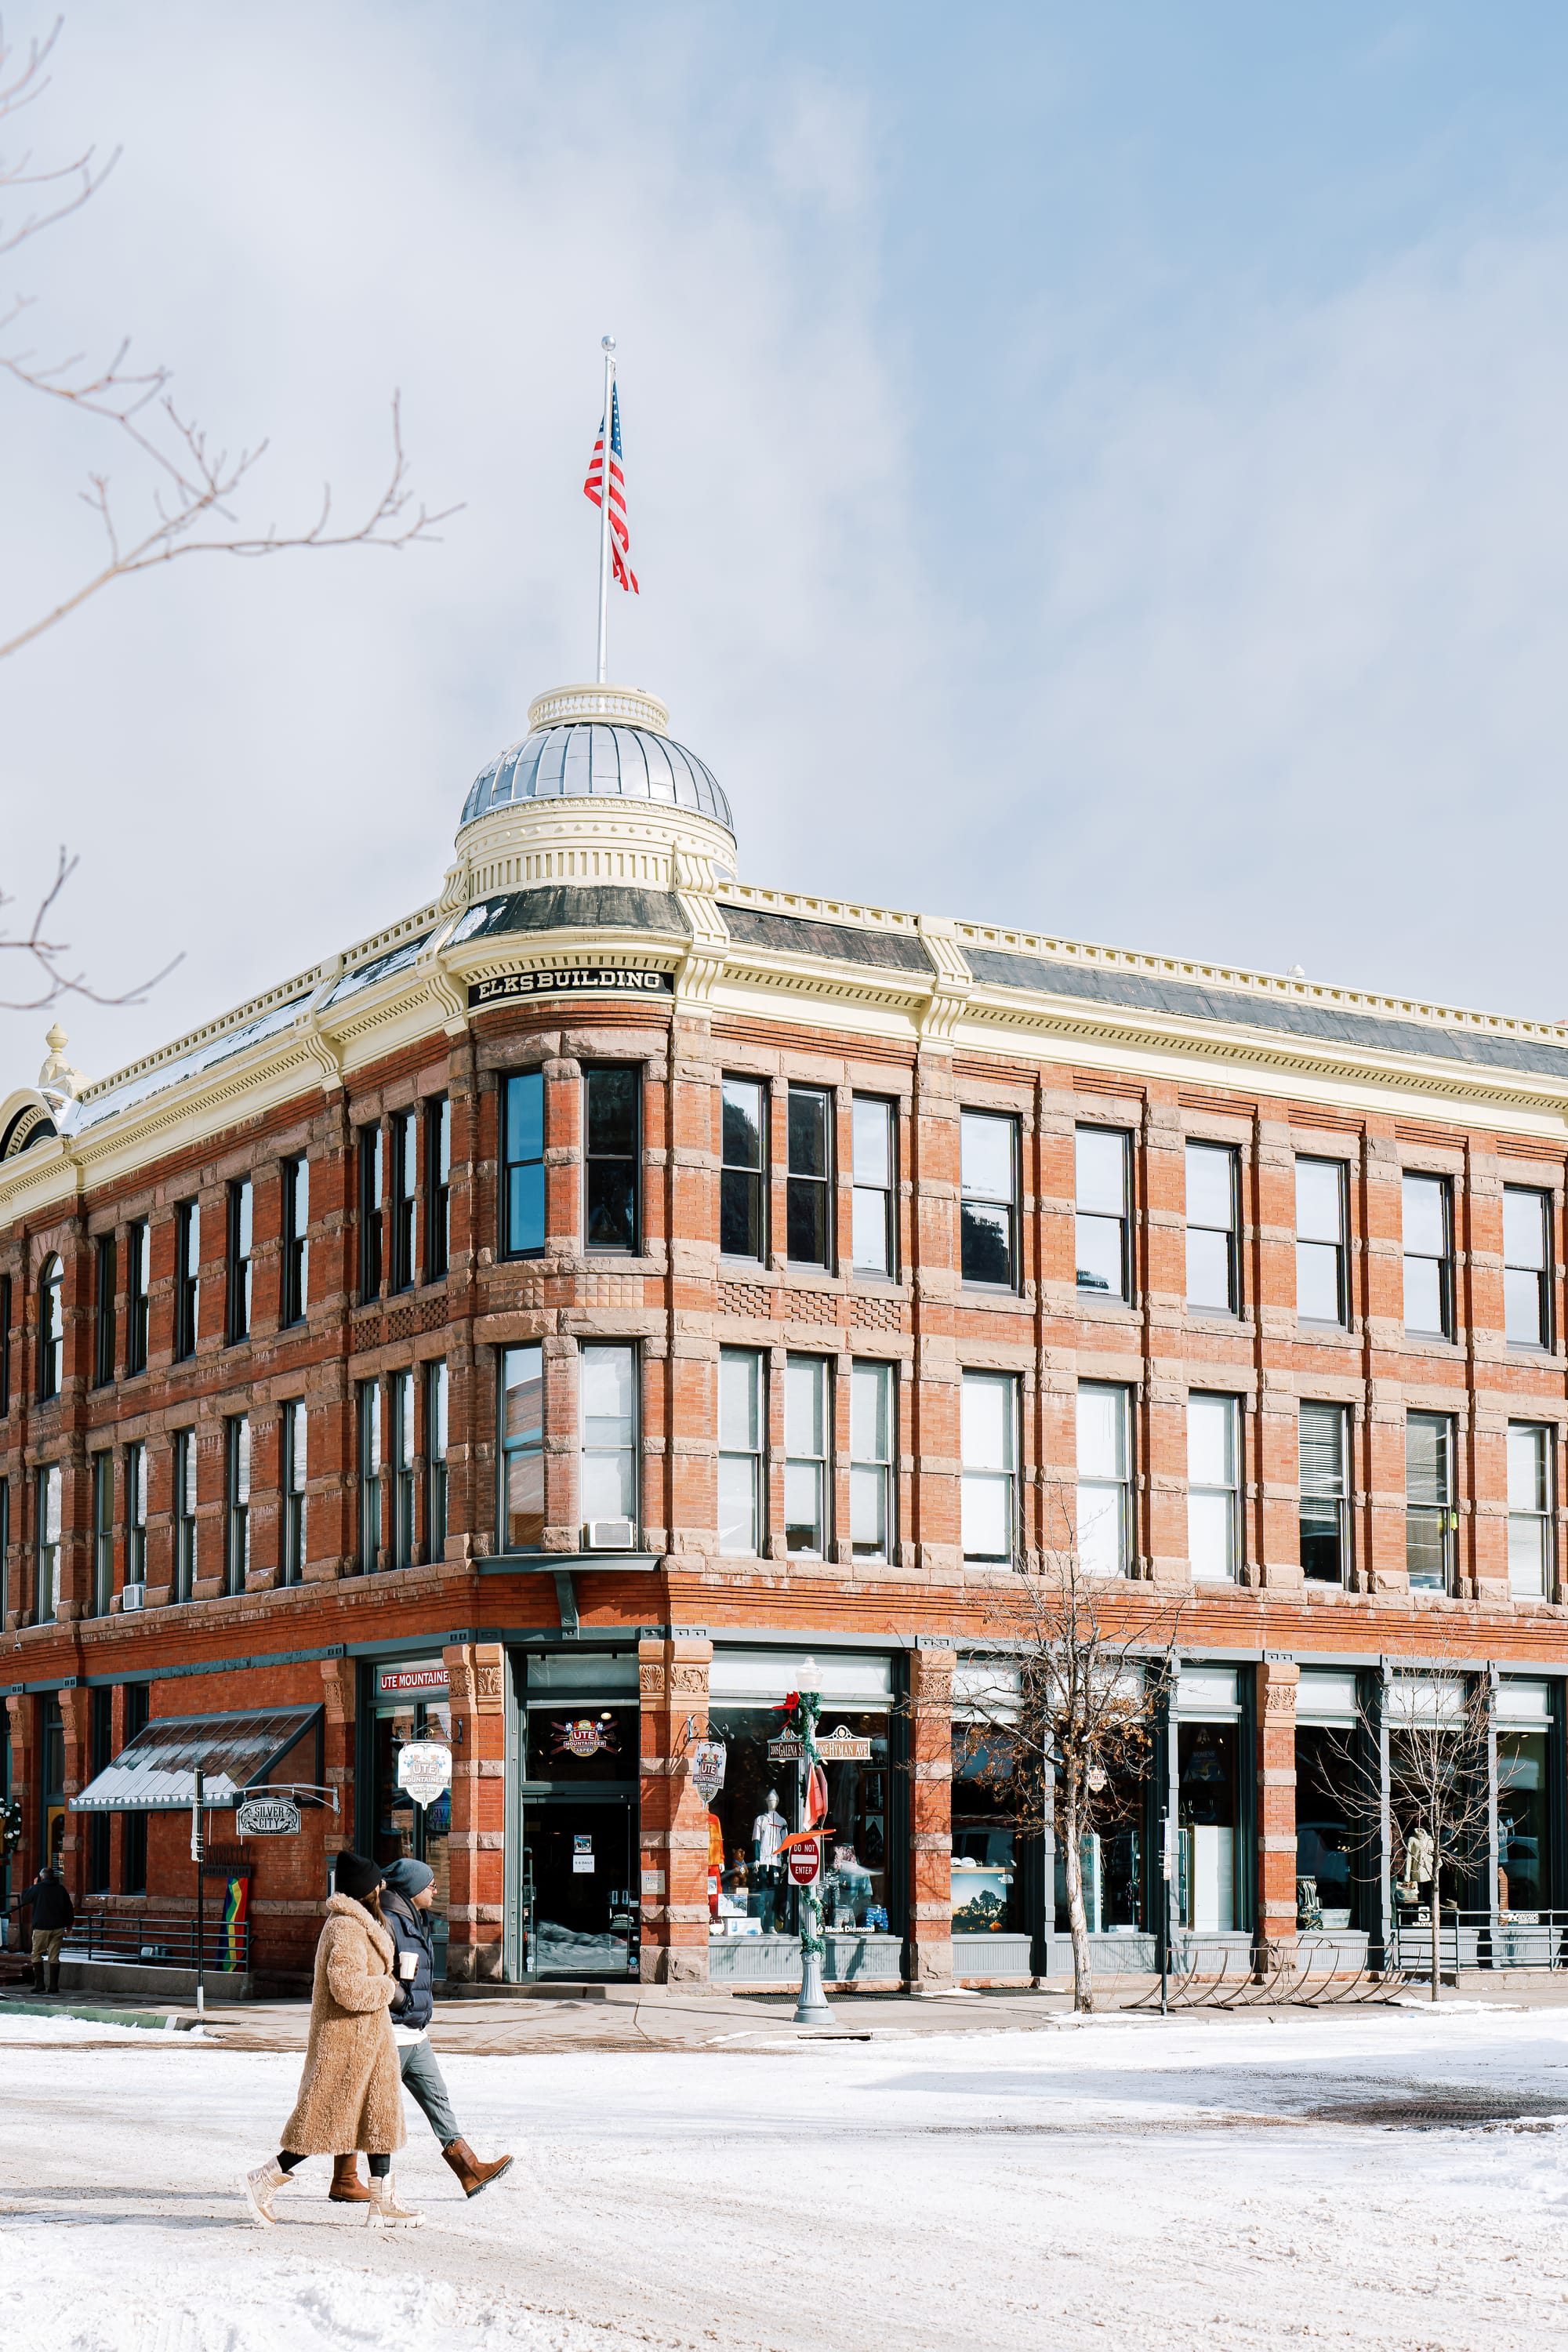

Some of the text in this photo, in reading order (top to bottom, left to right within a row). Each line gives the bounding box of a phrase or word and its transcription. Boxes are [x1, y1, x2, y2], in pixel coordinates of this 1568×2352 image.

[479, 971, 660, 1000] ELKS BUILDING
[381, 1671, 451, 1689] UTE MOUNTAINE
[573, 1731, 596, 1740] UTE
[779, 1743, 797, 1757] GALENA
[829, 1742, 853, 1757] HYMAN
[855, 1743, 868, 1757] AVE
[413, 1763, 437, 1775] UTE
[702, 1762, 717, 1775] UTE
[693, 1775, 722, 1784] MOUNTAINEER
[255, 1806, 284, 1817] SILVER
[260, 1817, 280, 1828] CITY
[804, 1844, 815, 1853] NOT
[795, 1866, 813, 1875] ENTER
